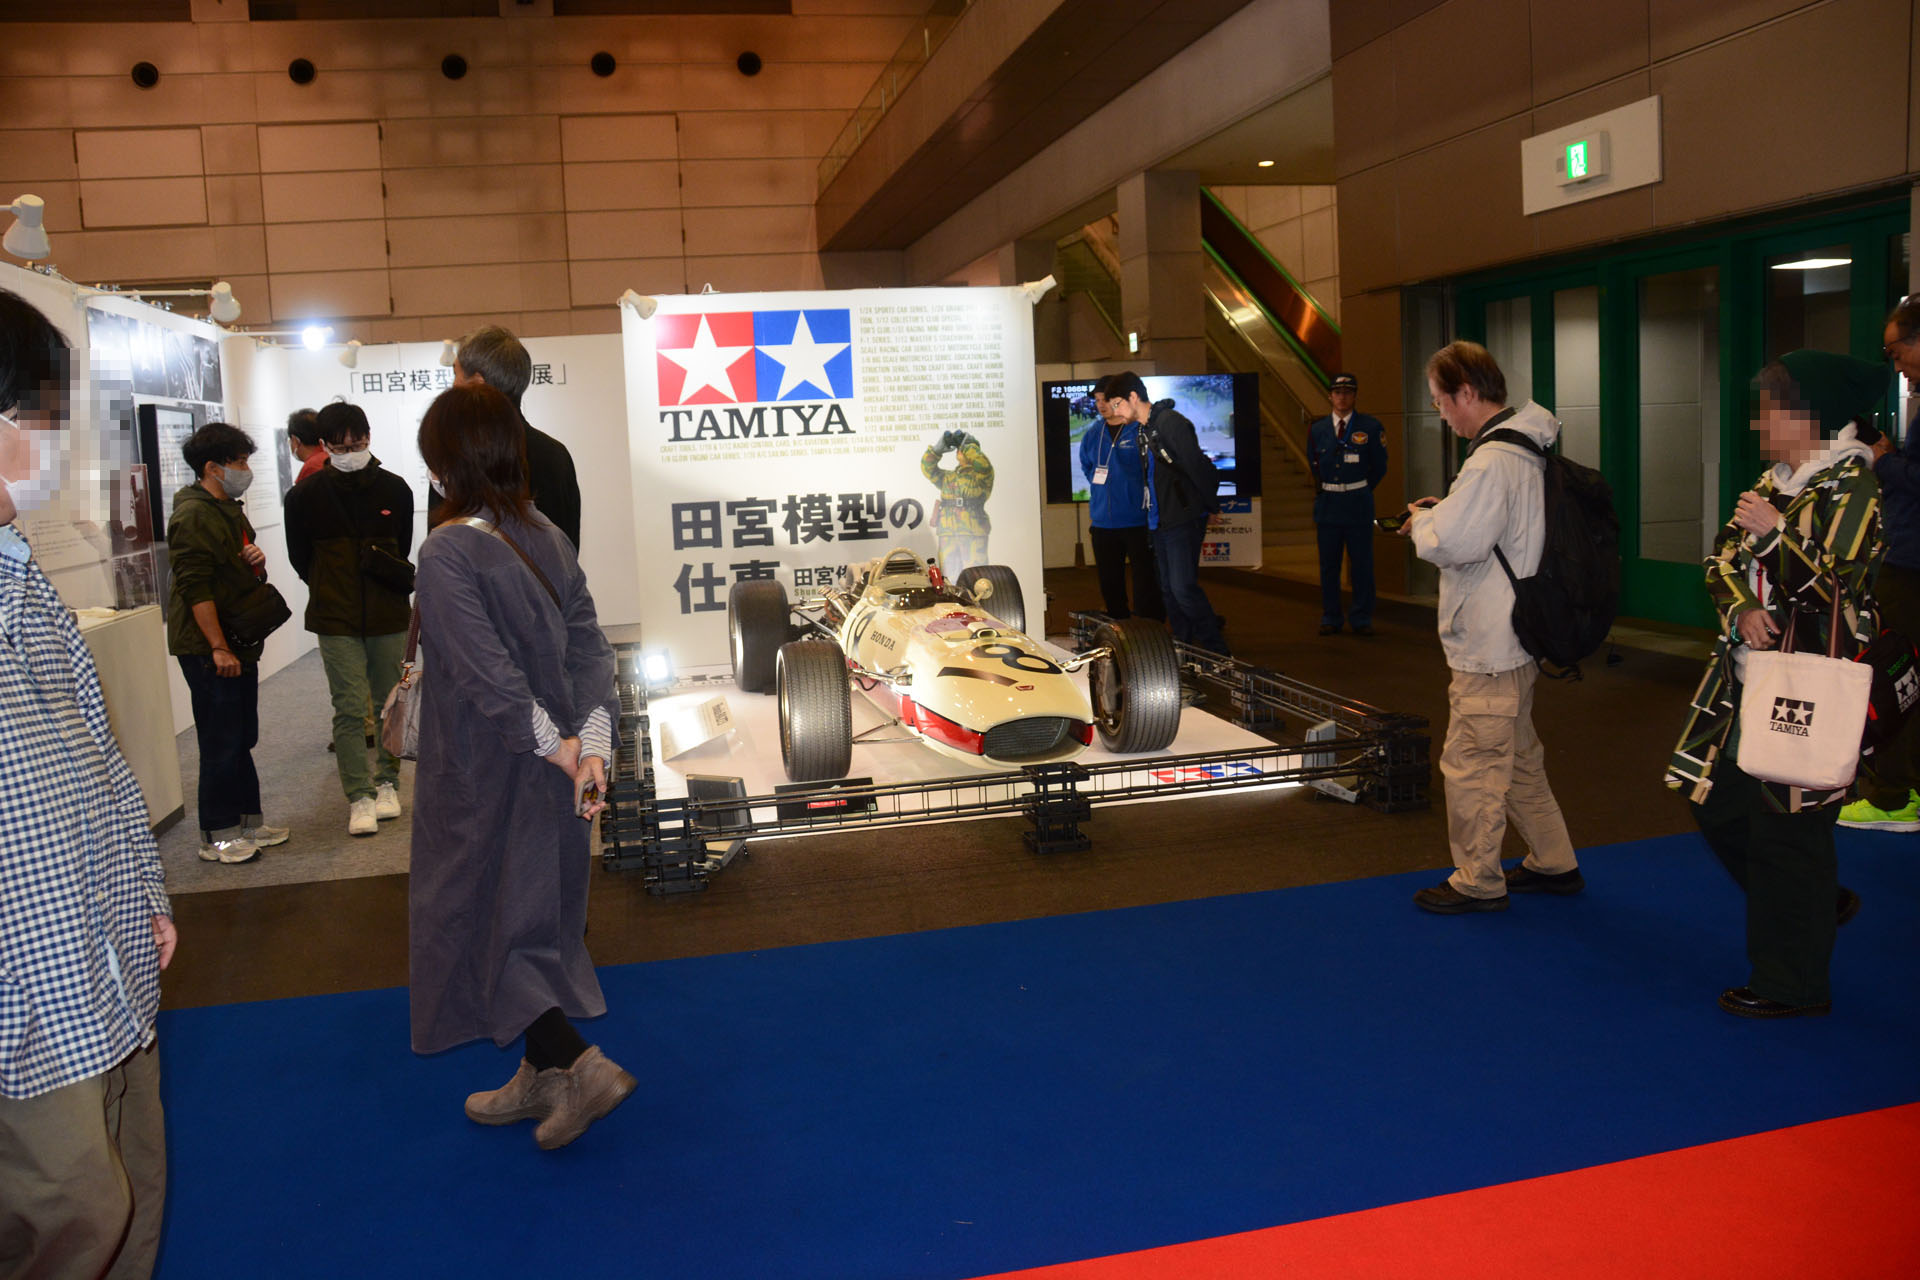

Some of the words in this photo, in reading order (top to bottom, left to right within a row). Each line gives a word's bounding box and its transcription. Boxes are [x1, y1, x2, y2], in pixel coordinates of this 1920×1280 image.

[874, 305, 894, 313] SPORTS
[896, 305, 907, 313] CAR
[860, 345, 876, 353] SCALE
[879, 345, 898, 353] RACING
[948, 343, 982, 351] MOTORCYCLE
[899, 354, 932, 362] MOTORCYCLE
[954, 352, 988, 361] EDUCATIONAL
[861, 365, 890, 373] STRUCTION
[928, 363, 944, 371] CRAFT
[966, 362, 982, 370] CRAFT
[883, 374, 900, 382] SOLAR
[950, 372, 982, 380] PREHISTORIC
[984, 372, 1004, 380] WORLD
[897, 384, 917, 392] REMOTE
[918, 383, 941, 391] CONTROL
[956, 382, 969, 390] TANK
[863, 394, 888, 402] AIRCRAFT
[927, 392, 952, 400] MILITARY
[954, 391, 983, 400] MINIATURE
[879, 403, 906, 411] AIRCRAFT
[660, 404, 856, 442] TAMIYA
[864, 414, 882, 422] WATER
[970, 421, 984, 429] TANK
[733, 442, 749, 450] RADIO
[751, 441, 774, 449] CONTROL
[811, 448, 832, 457] TAMIYA
[853, 446, 874, 455] TAMIYA
[672, 490, 924, 551] 田宮模型の
[870, 630, 897, 652] HONDA
[1770, 721, 1810, 737] TAMIYA
